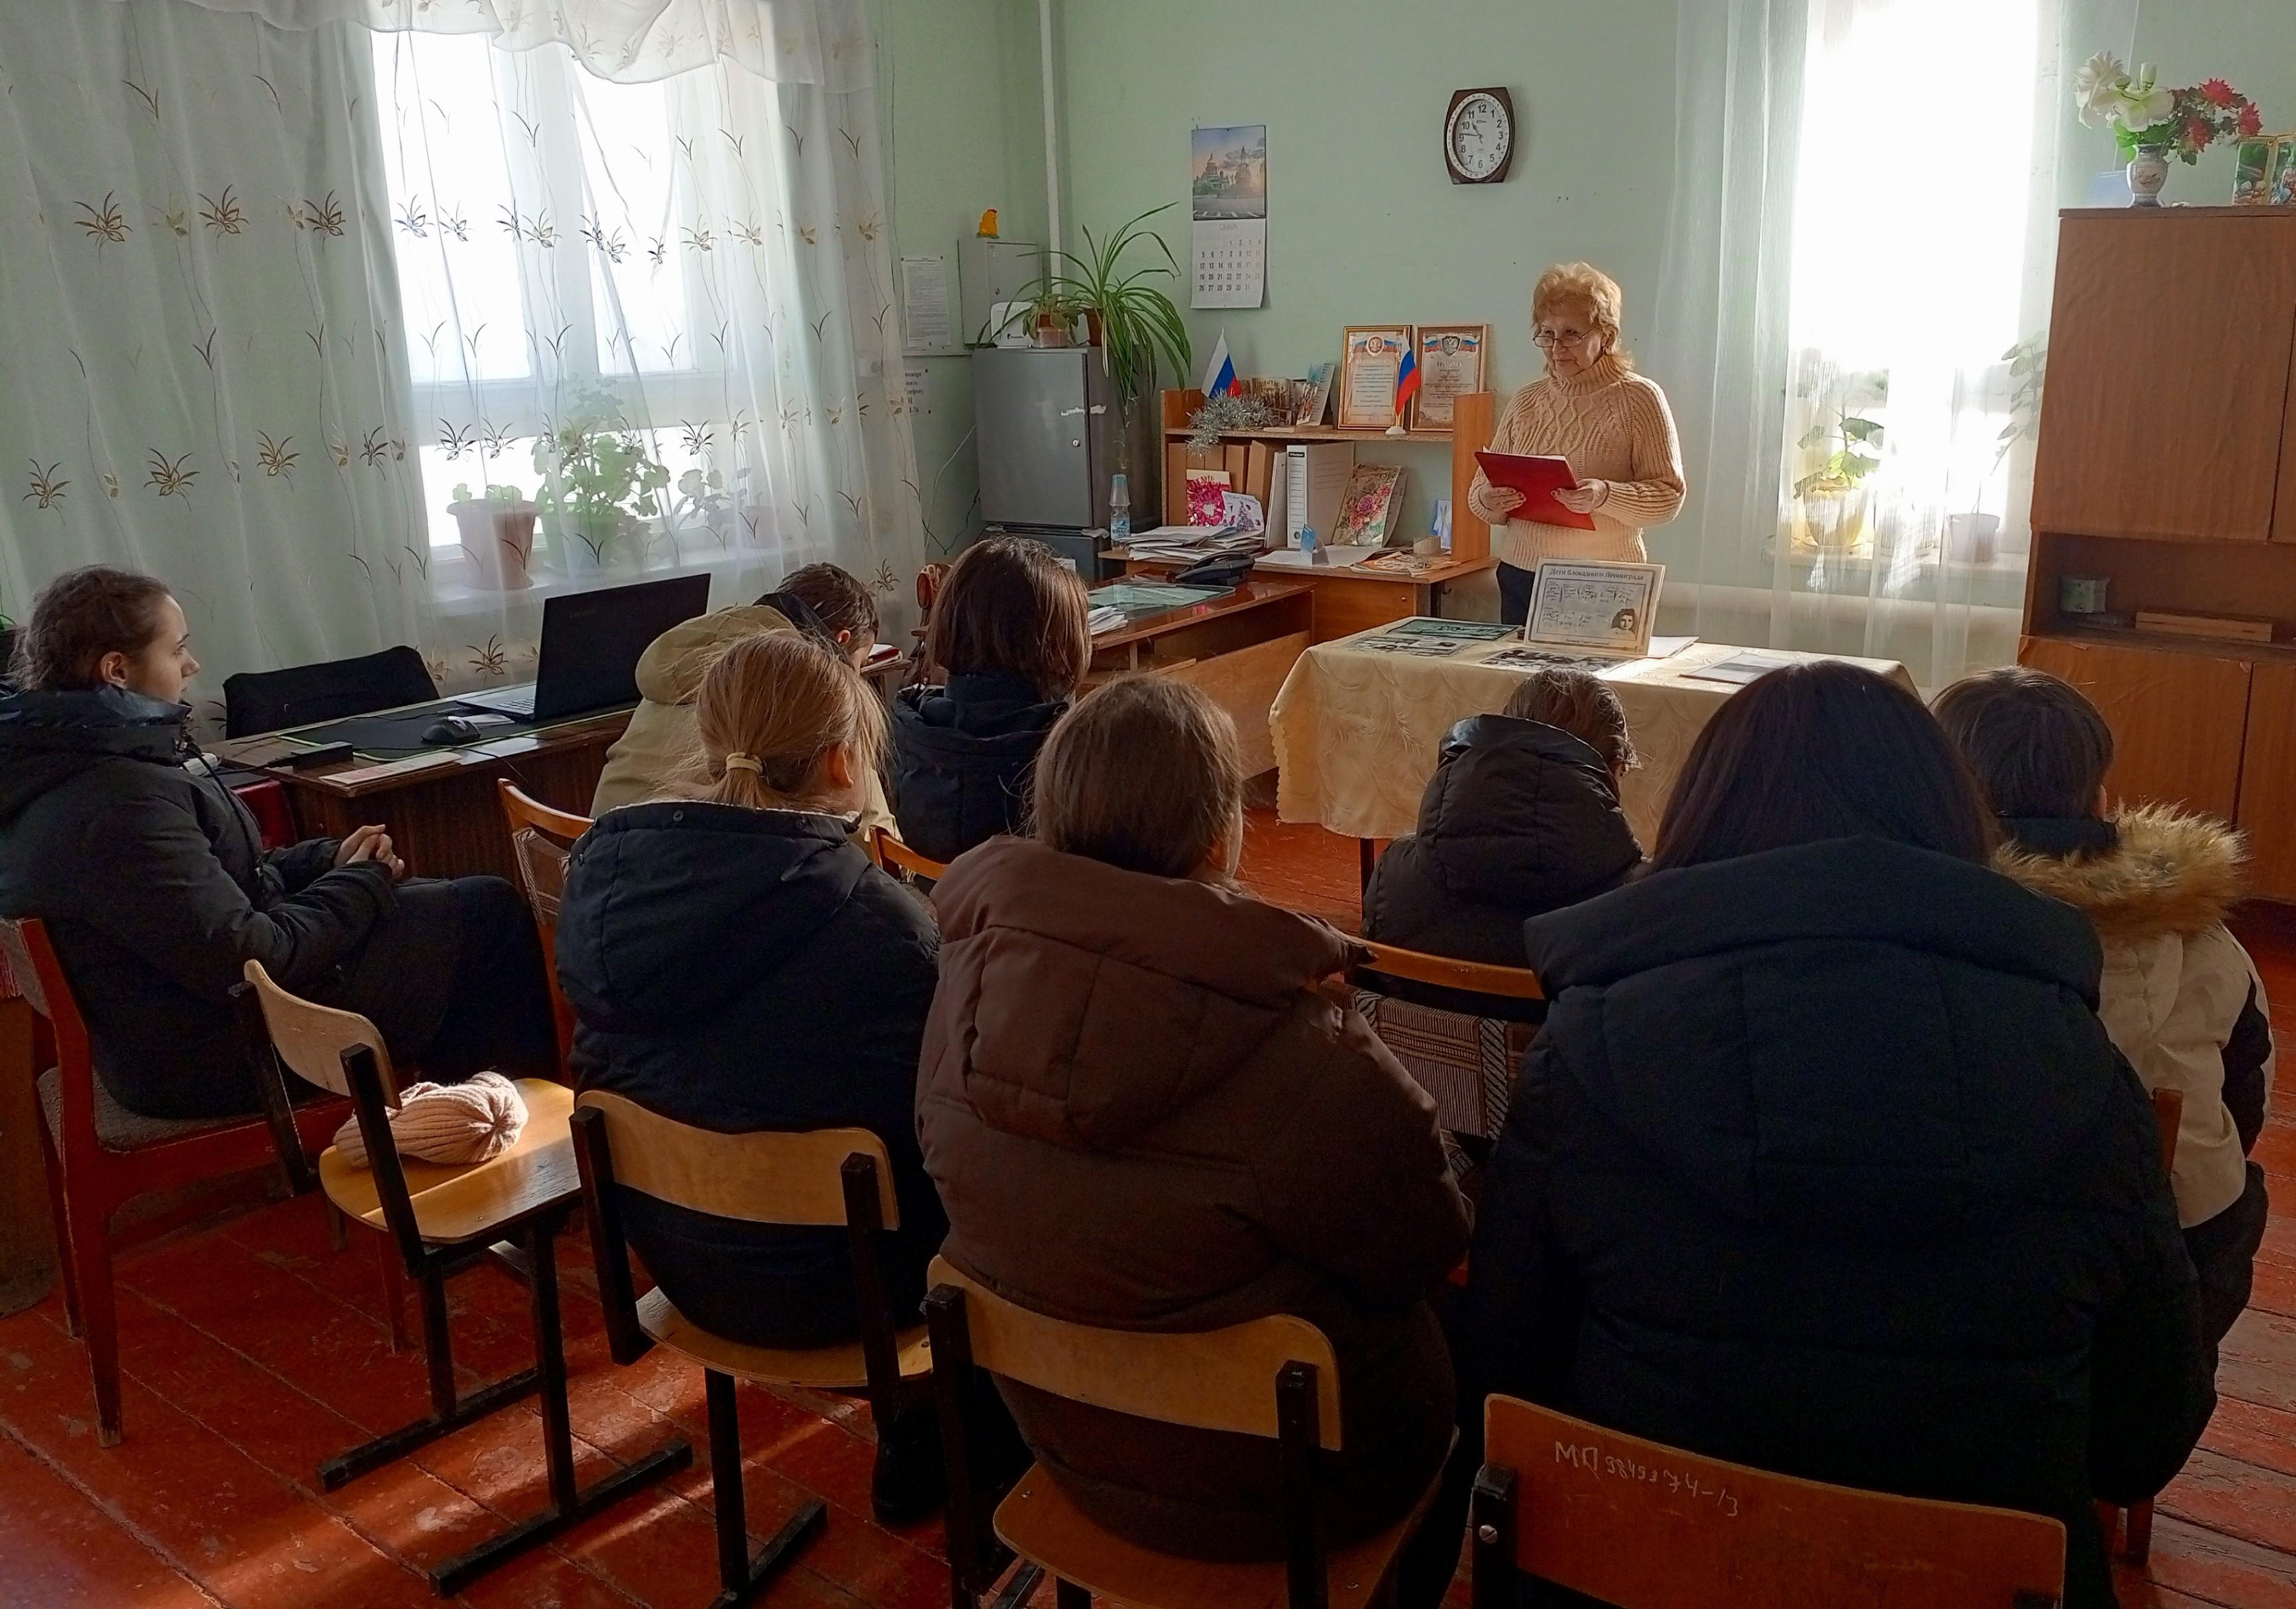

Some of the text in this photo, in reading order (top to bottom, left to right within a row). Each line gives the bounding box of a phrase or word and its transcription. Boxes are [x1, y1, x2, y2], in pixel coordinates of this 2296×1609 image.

[1478, 104, 1487, 113] 12
[1491, 109, 1494, 118] 1
[1461, 121, 1470, 130] 10
[1496, 119, 1502, 128] 2
[1459, 133, 1464, 142] 9
[1498, 131, 1503, 140] 3
[1460, 144, 1466, 153] 8
[1496, 142, 1501, 151] 4
[1468, 155, 1473, 164] 7
[1490, 154, 1494, 162] 5
[1478, 160, 1483, 168] 6
[1568, 569, 1604, 578] блокадного
[1604, 571, 1643, 581] Ленинграда
